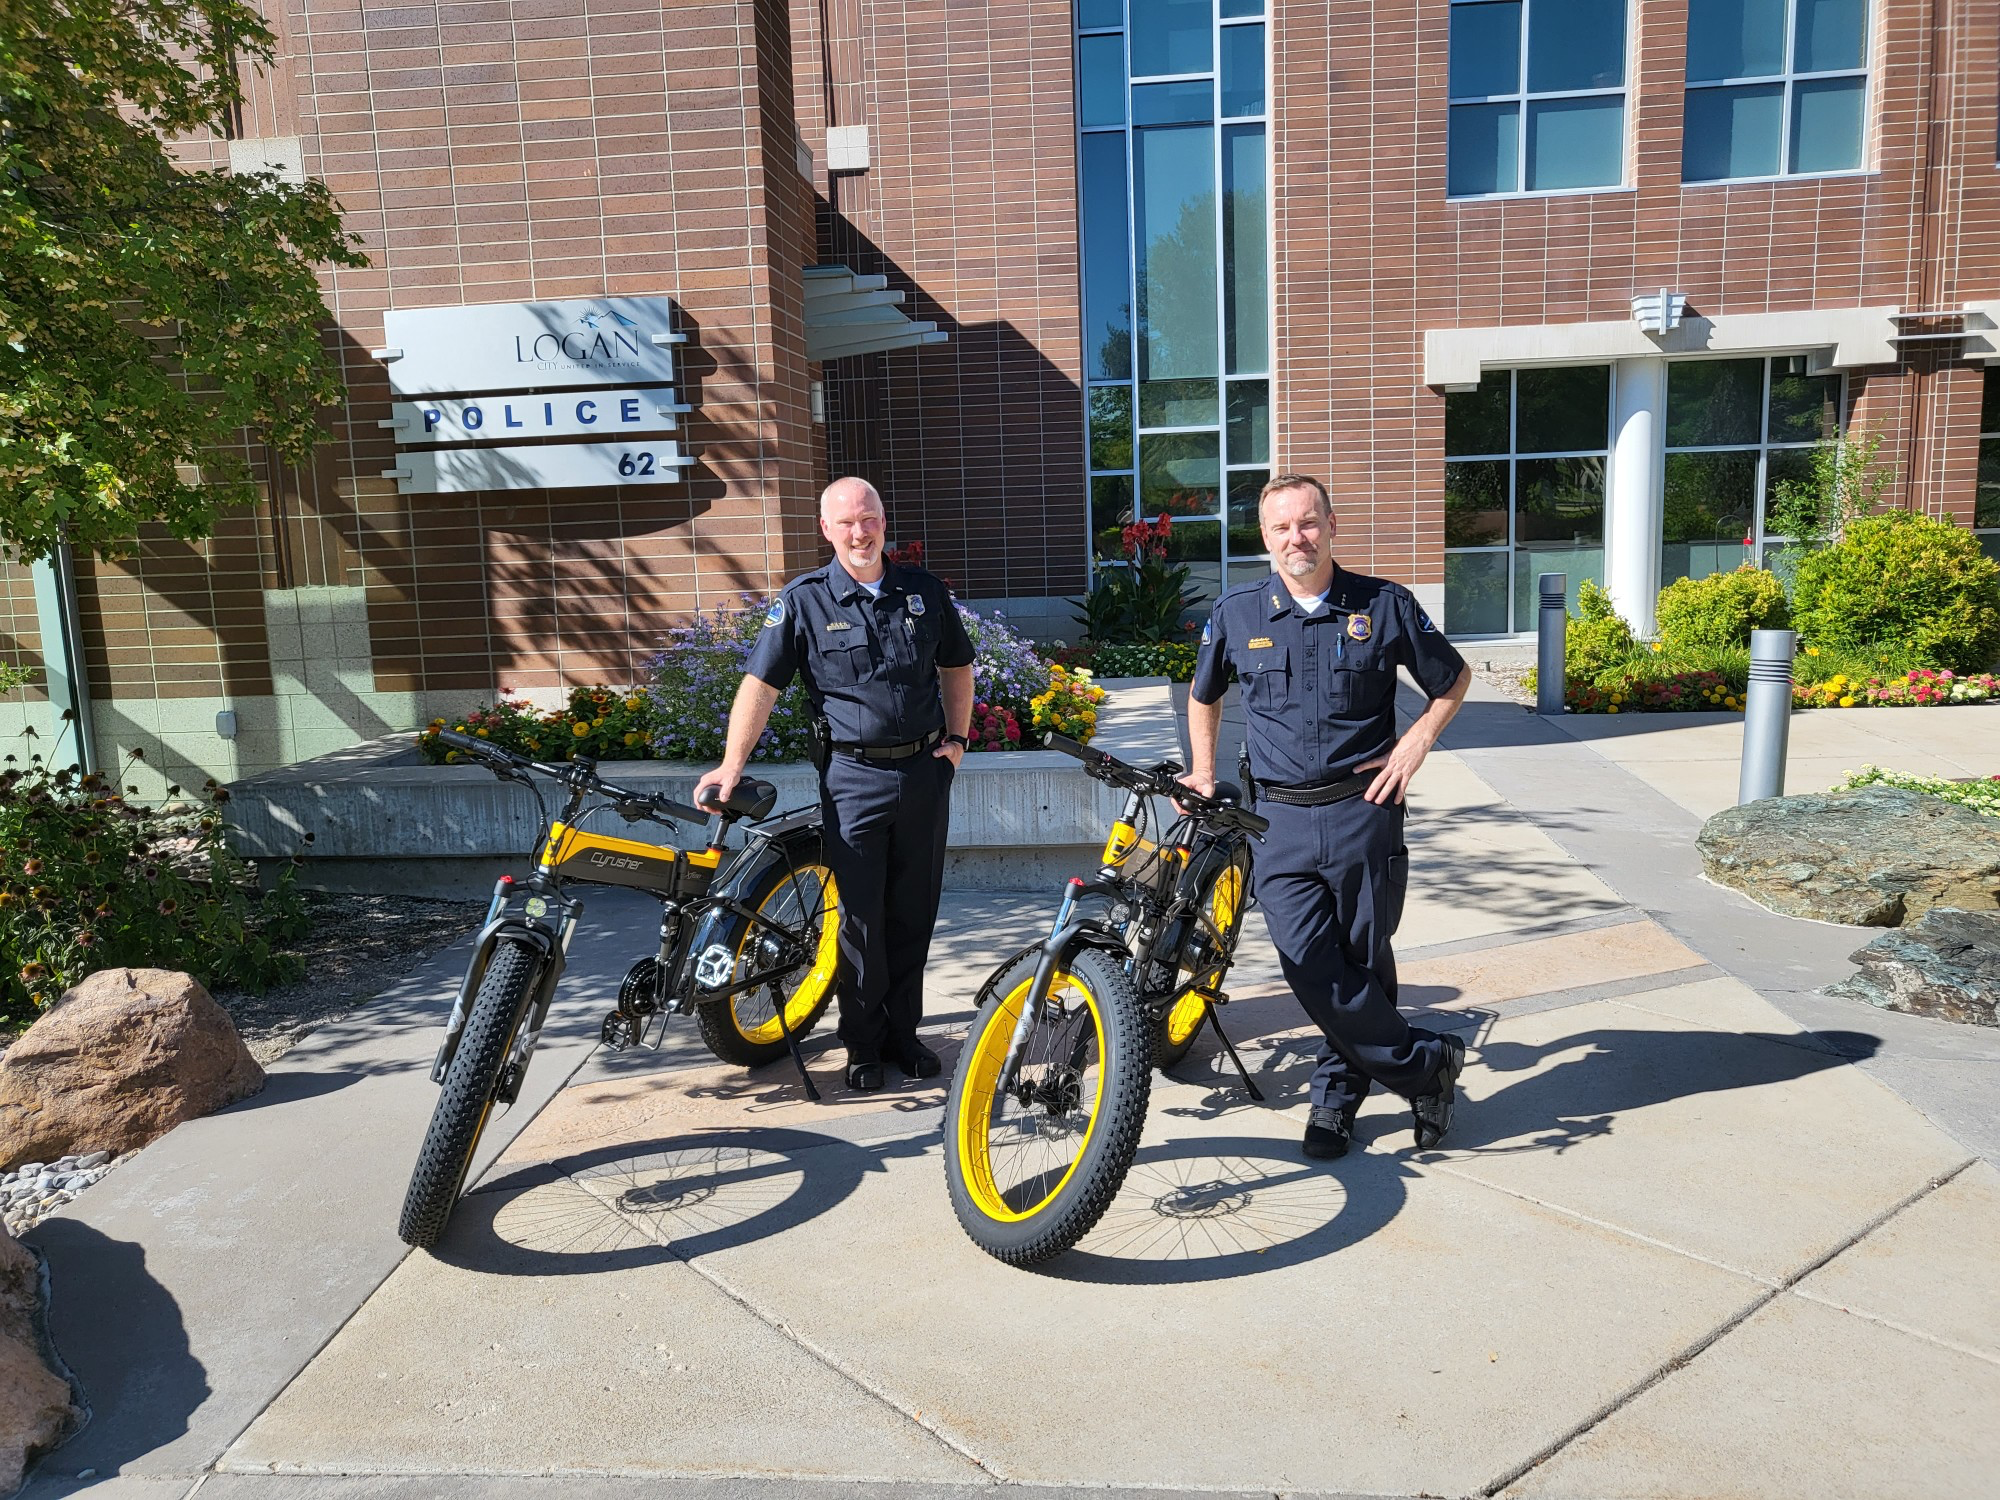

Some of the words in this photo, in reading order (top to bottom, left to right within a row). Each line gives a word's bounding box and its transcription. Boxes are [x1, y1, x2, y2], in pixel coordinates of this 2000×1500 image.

[515, 330, 640, 362] LOGAN
[537, 362, 559, 371] CITY
[607, 361, 640, 369] SERVICE
[424, 399, 641, 433] POLICE
[618, 452, 655, 477] 62
[590, 851, 644, 870] Cyrusher
